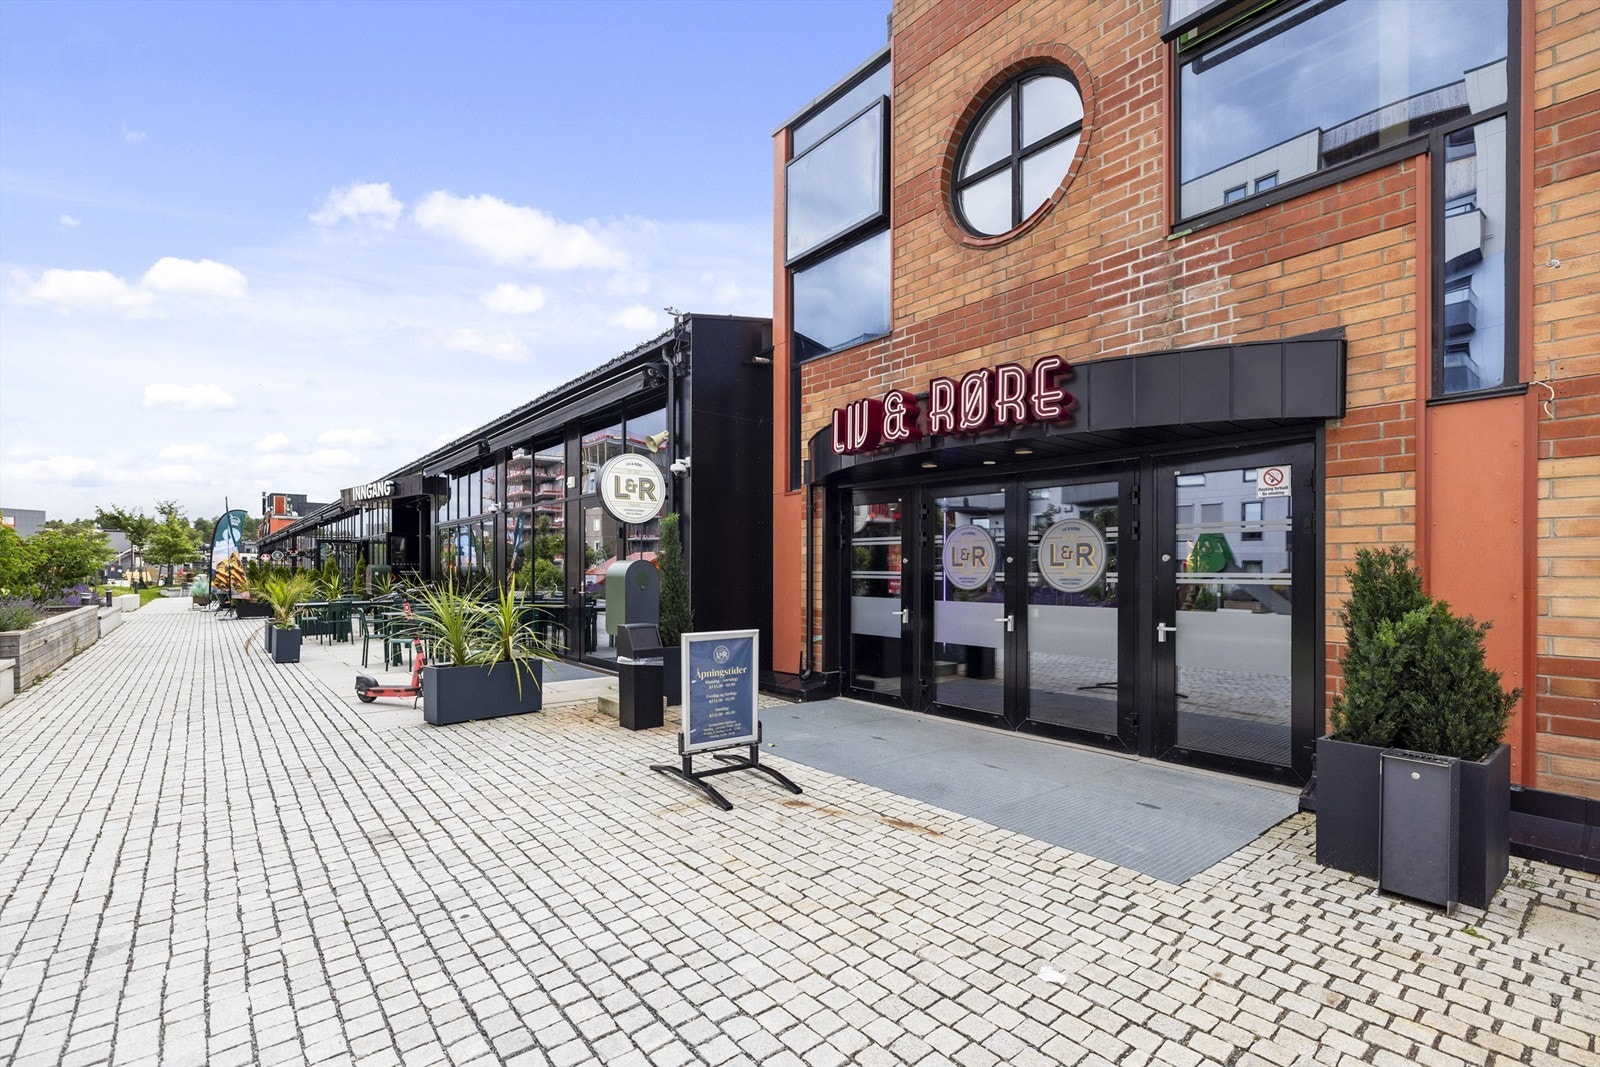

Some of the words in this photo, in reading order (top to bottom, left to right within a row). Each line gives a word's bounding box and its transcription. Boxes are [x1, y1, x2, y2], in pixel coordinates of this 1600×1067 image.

[833, 398, 871, 454] LIV
[883, 390, 911, 441] &
[929, 356, 1066, 433] RØRE
[352, 480, 394, 501] INNGANG
[614, 475, 657, 502] L&R
[952, 545, 989, 569] L&R
[1049, 542, 1098, 569] L&R
[695, 666, 748, 680] Åpningstider
